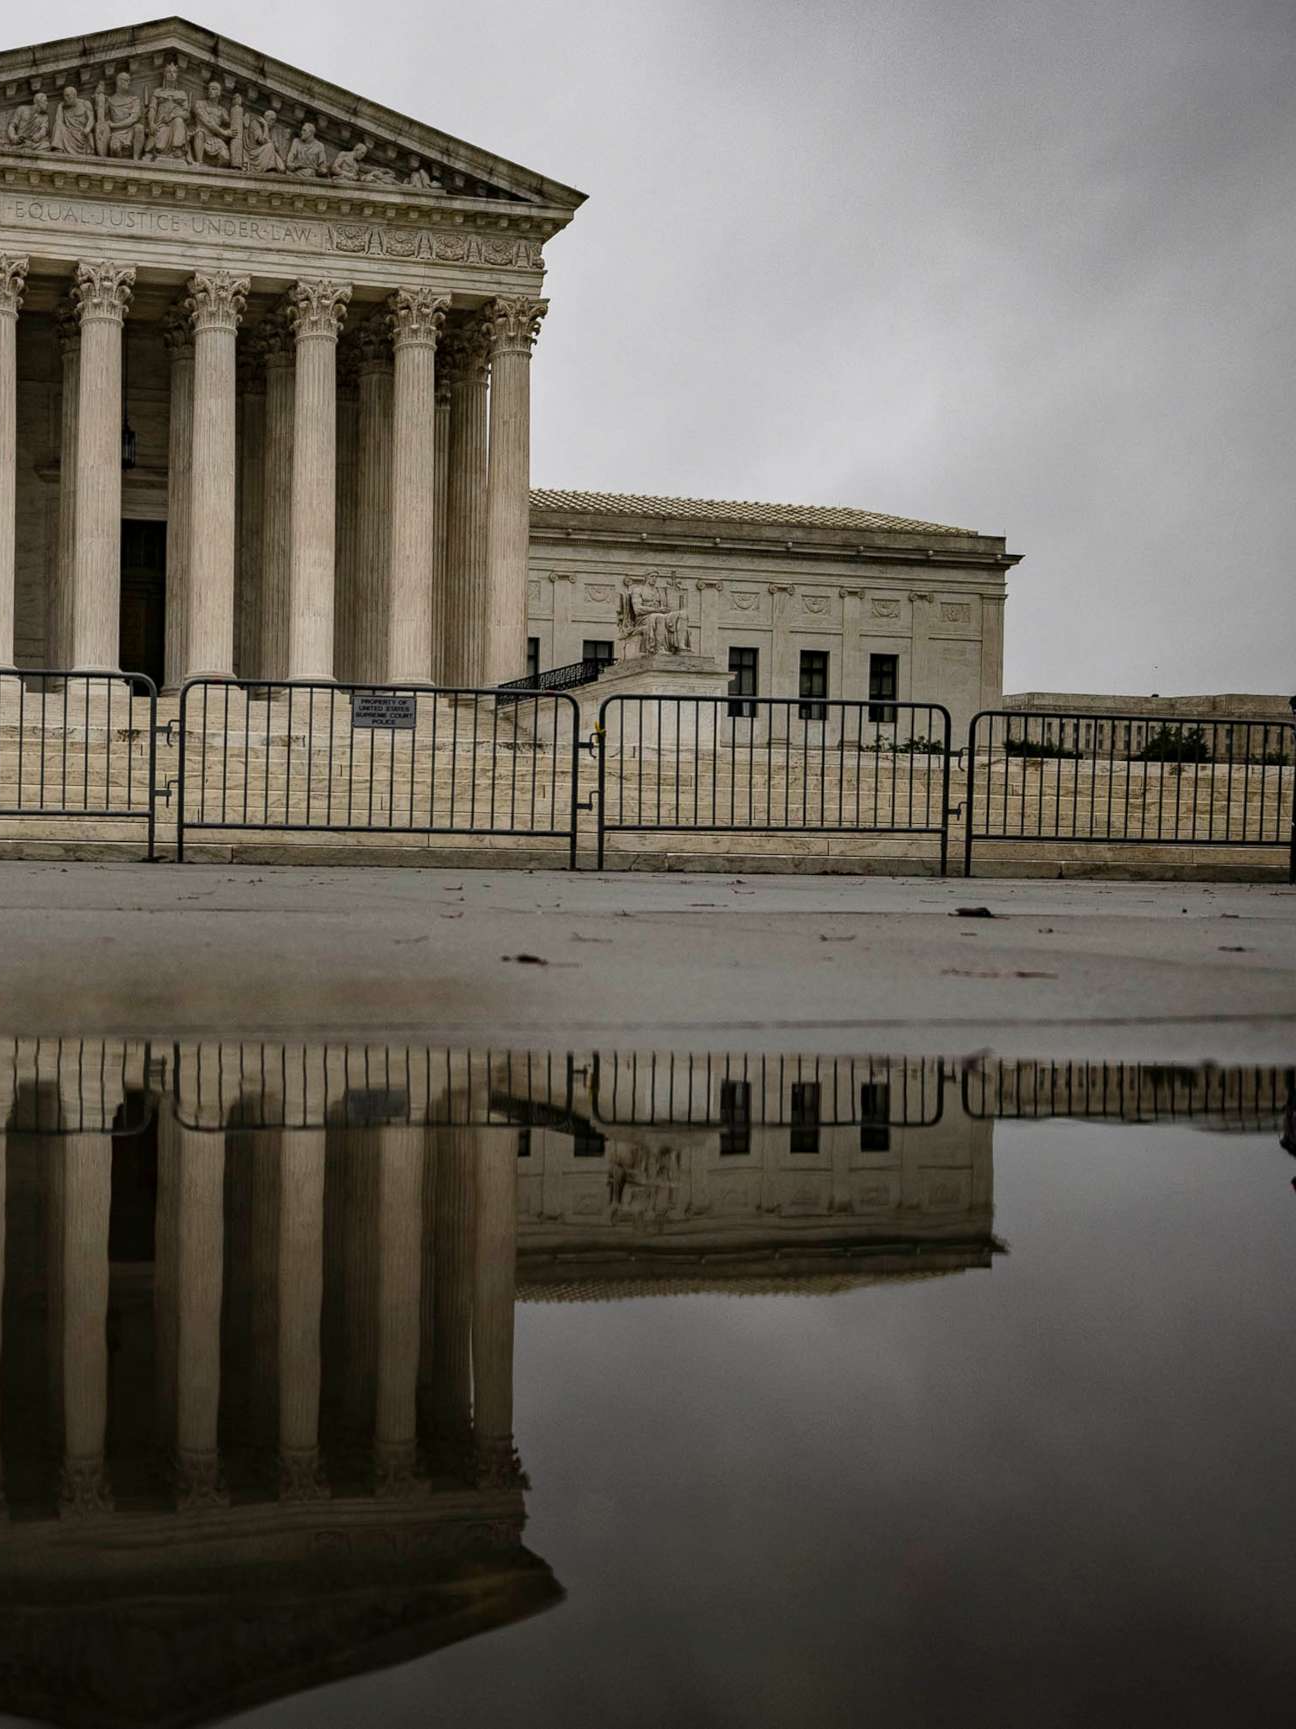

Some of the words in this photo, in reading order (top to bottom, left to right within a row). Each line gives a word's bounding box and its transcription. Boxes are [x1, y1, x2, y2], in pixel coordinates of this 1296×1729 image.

[15, 201, 90, 225] EQUAL
[93, 209, 180, 232] JUSTICE
[192, 218, 263, 240] UNDER
[271, 226, 313, 242] LAW
